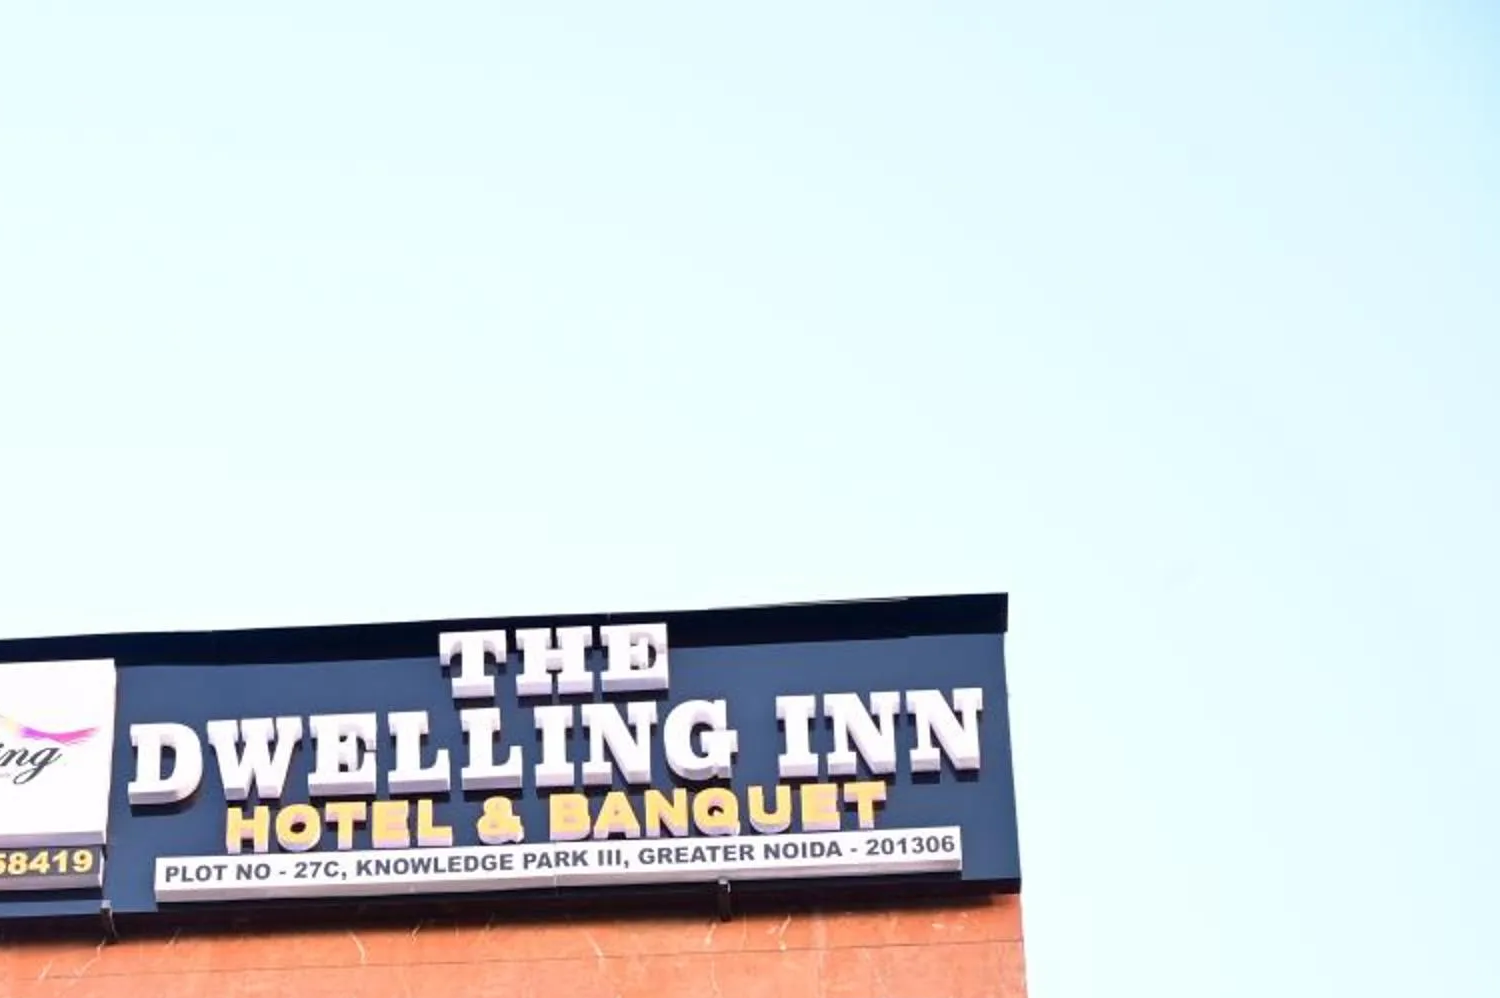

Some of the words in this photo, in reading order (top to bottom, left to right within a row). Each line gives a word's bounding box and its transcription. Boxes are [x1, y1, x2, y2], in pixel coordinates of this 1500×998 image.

[439, 623, 669, 697] THE
[127, 699, 739, 805] DWELLING
[775, 687, 984, 778] INN
[225, 799, 454, 854] HOTEL
[476, 796, 525, 844] &
[549, 780, 888, 842] BANQUET
[164, 864, 228, 883] PLOT
[235, 863, 271, 880] NO
[293, 860, 348, 880] 27C,
[355, 853, 514, 878] KNOWLEDGE
[522, 850, 589, 869] PARK
[596, 848, 631, 869] III,
[638, 844, 757, 866] GREATER
[763, 840, 844, 862] NOIDA
[866, 835, 956, 856] 201306
